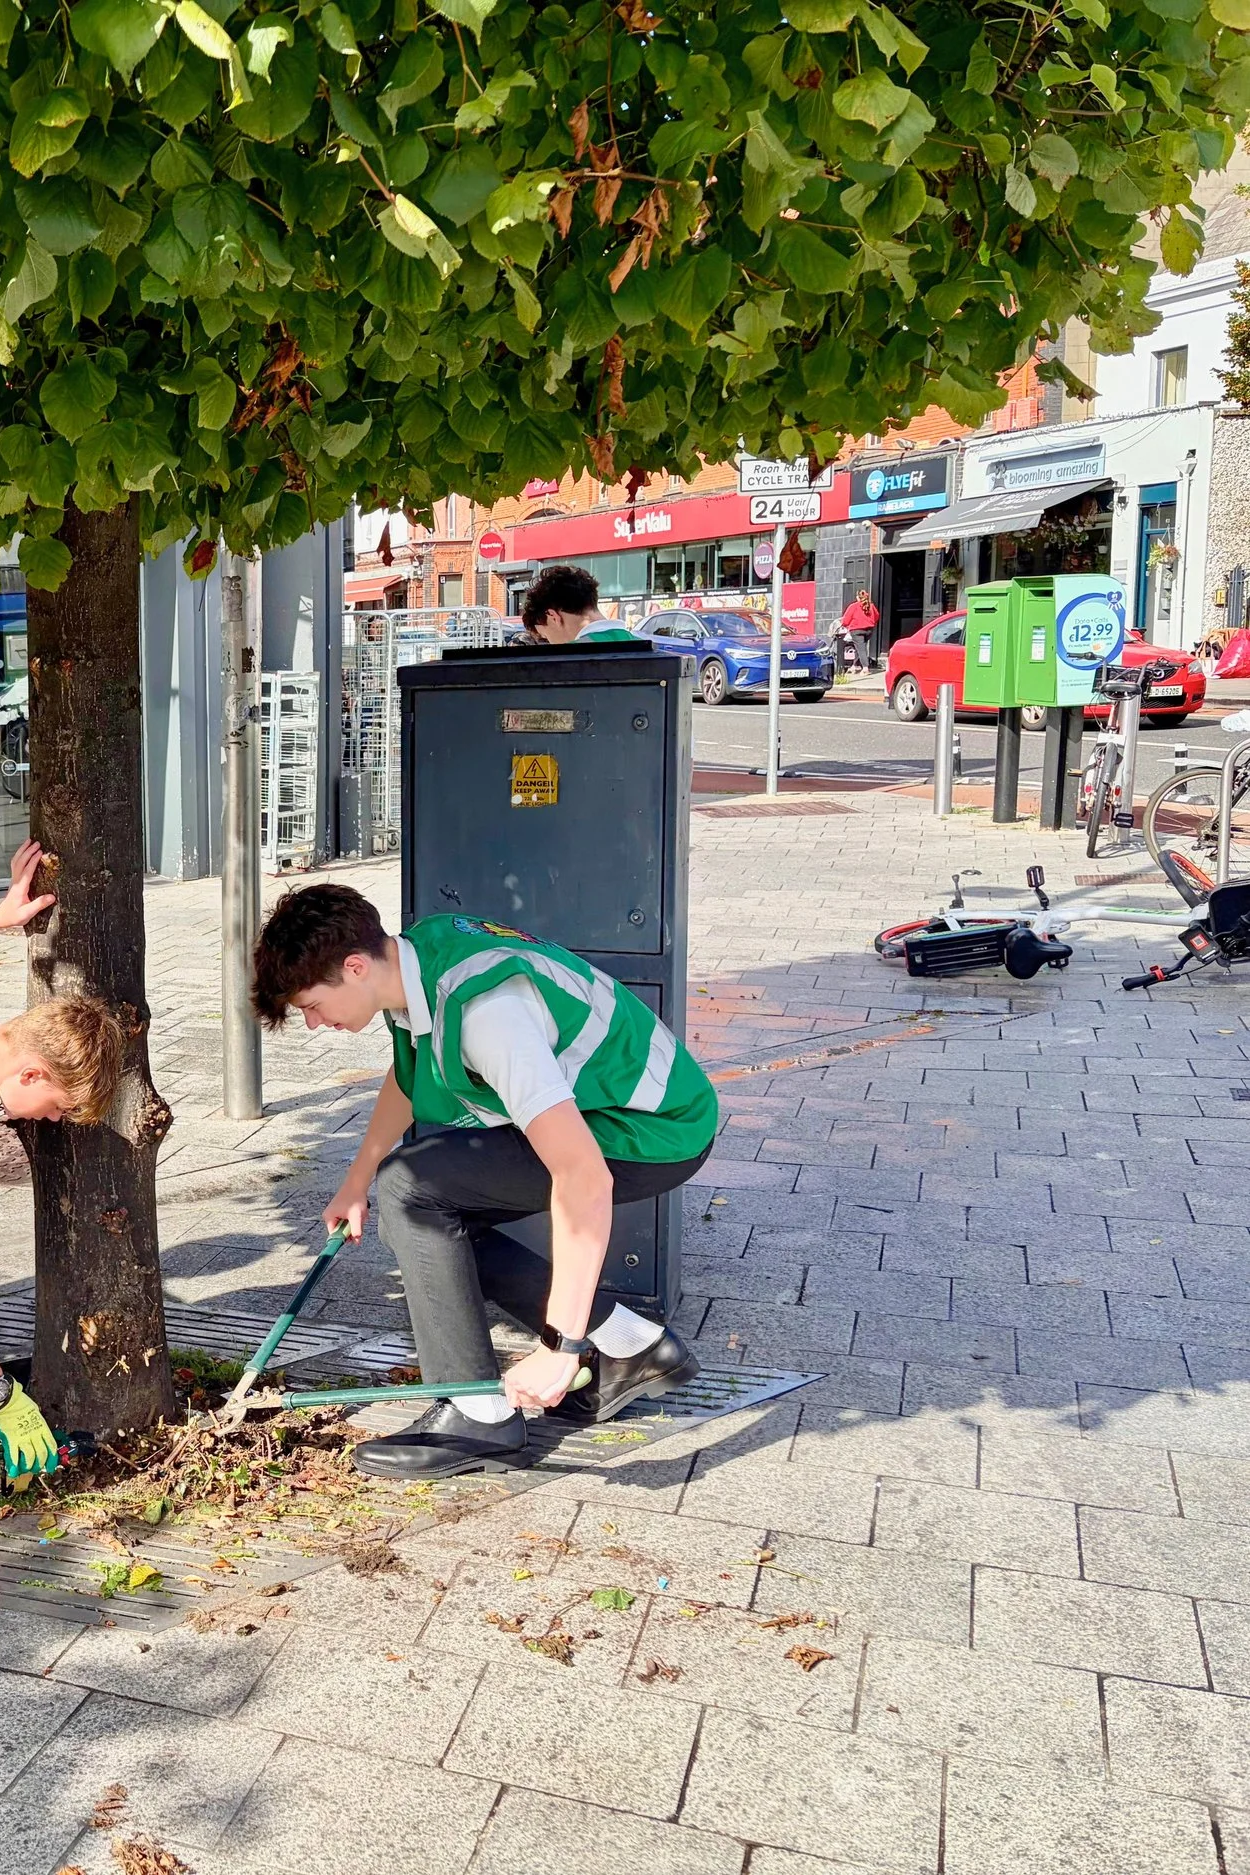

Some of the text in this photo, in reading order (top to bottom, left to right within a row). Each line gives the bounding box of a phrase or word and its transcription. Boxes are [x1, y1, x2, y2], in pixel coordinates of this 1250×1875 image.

[753, 462, 809, 474] Raon Roth
[1009, 461, 1099, 485] blooming amazing
[747, 474, 824, 486] CYCLE TRAK
[787, 498, 807, 507] Uair
[755, 499, 784, 519] 24
[787, 507, 816, 518] HOUR
[755, 555, 773, 565] PIZZA
[1069, 623, 1113, 643] €12.99
